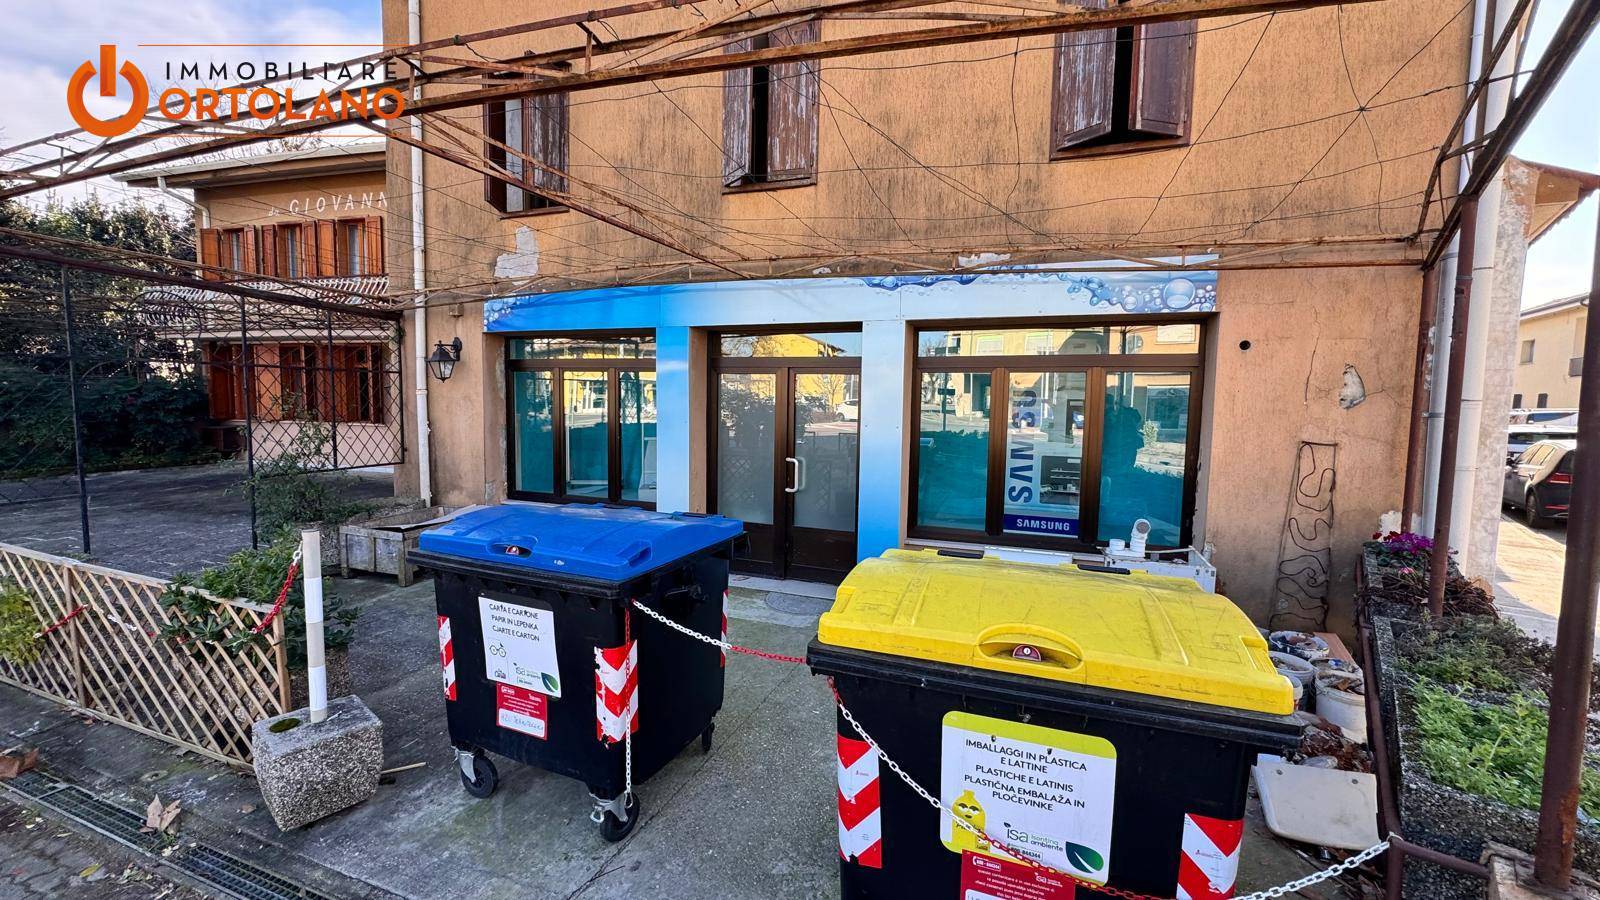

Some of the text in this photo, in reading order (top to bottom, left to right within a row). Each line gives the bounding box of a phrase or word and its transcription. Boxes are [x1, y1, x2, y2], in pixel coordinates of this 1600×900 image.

[1016, 518, 1070, 530] SAMSUNG
[489, 604, 507, 612] CARTA
[512, 608, 539, 620] CARTONE
[492, 614, 506, 624] PAPIR
[514, 620, 539, 631] LEPENKA
[516, 631, 540, 642] CARTON
[965, 739, 1087, 771] IMBALLAGGI IN PLASTICA
[1008, 758, 1048, 774] LATTINE
[976, 764, 1026, 782] PLASTICHE
[1036, 778, 1074, 792] LATINIS
[964, 774, 1085, 808] PLASTIČNA EMBALAŽA IN
[992, 790, 1054, 812] PLOČEVINKE
[1005, 824, 1028, 843] isa
[1030, 840, 1064, 852] ambiente
